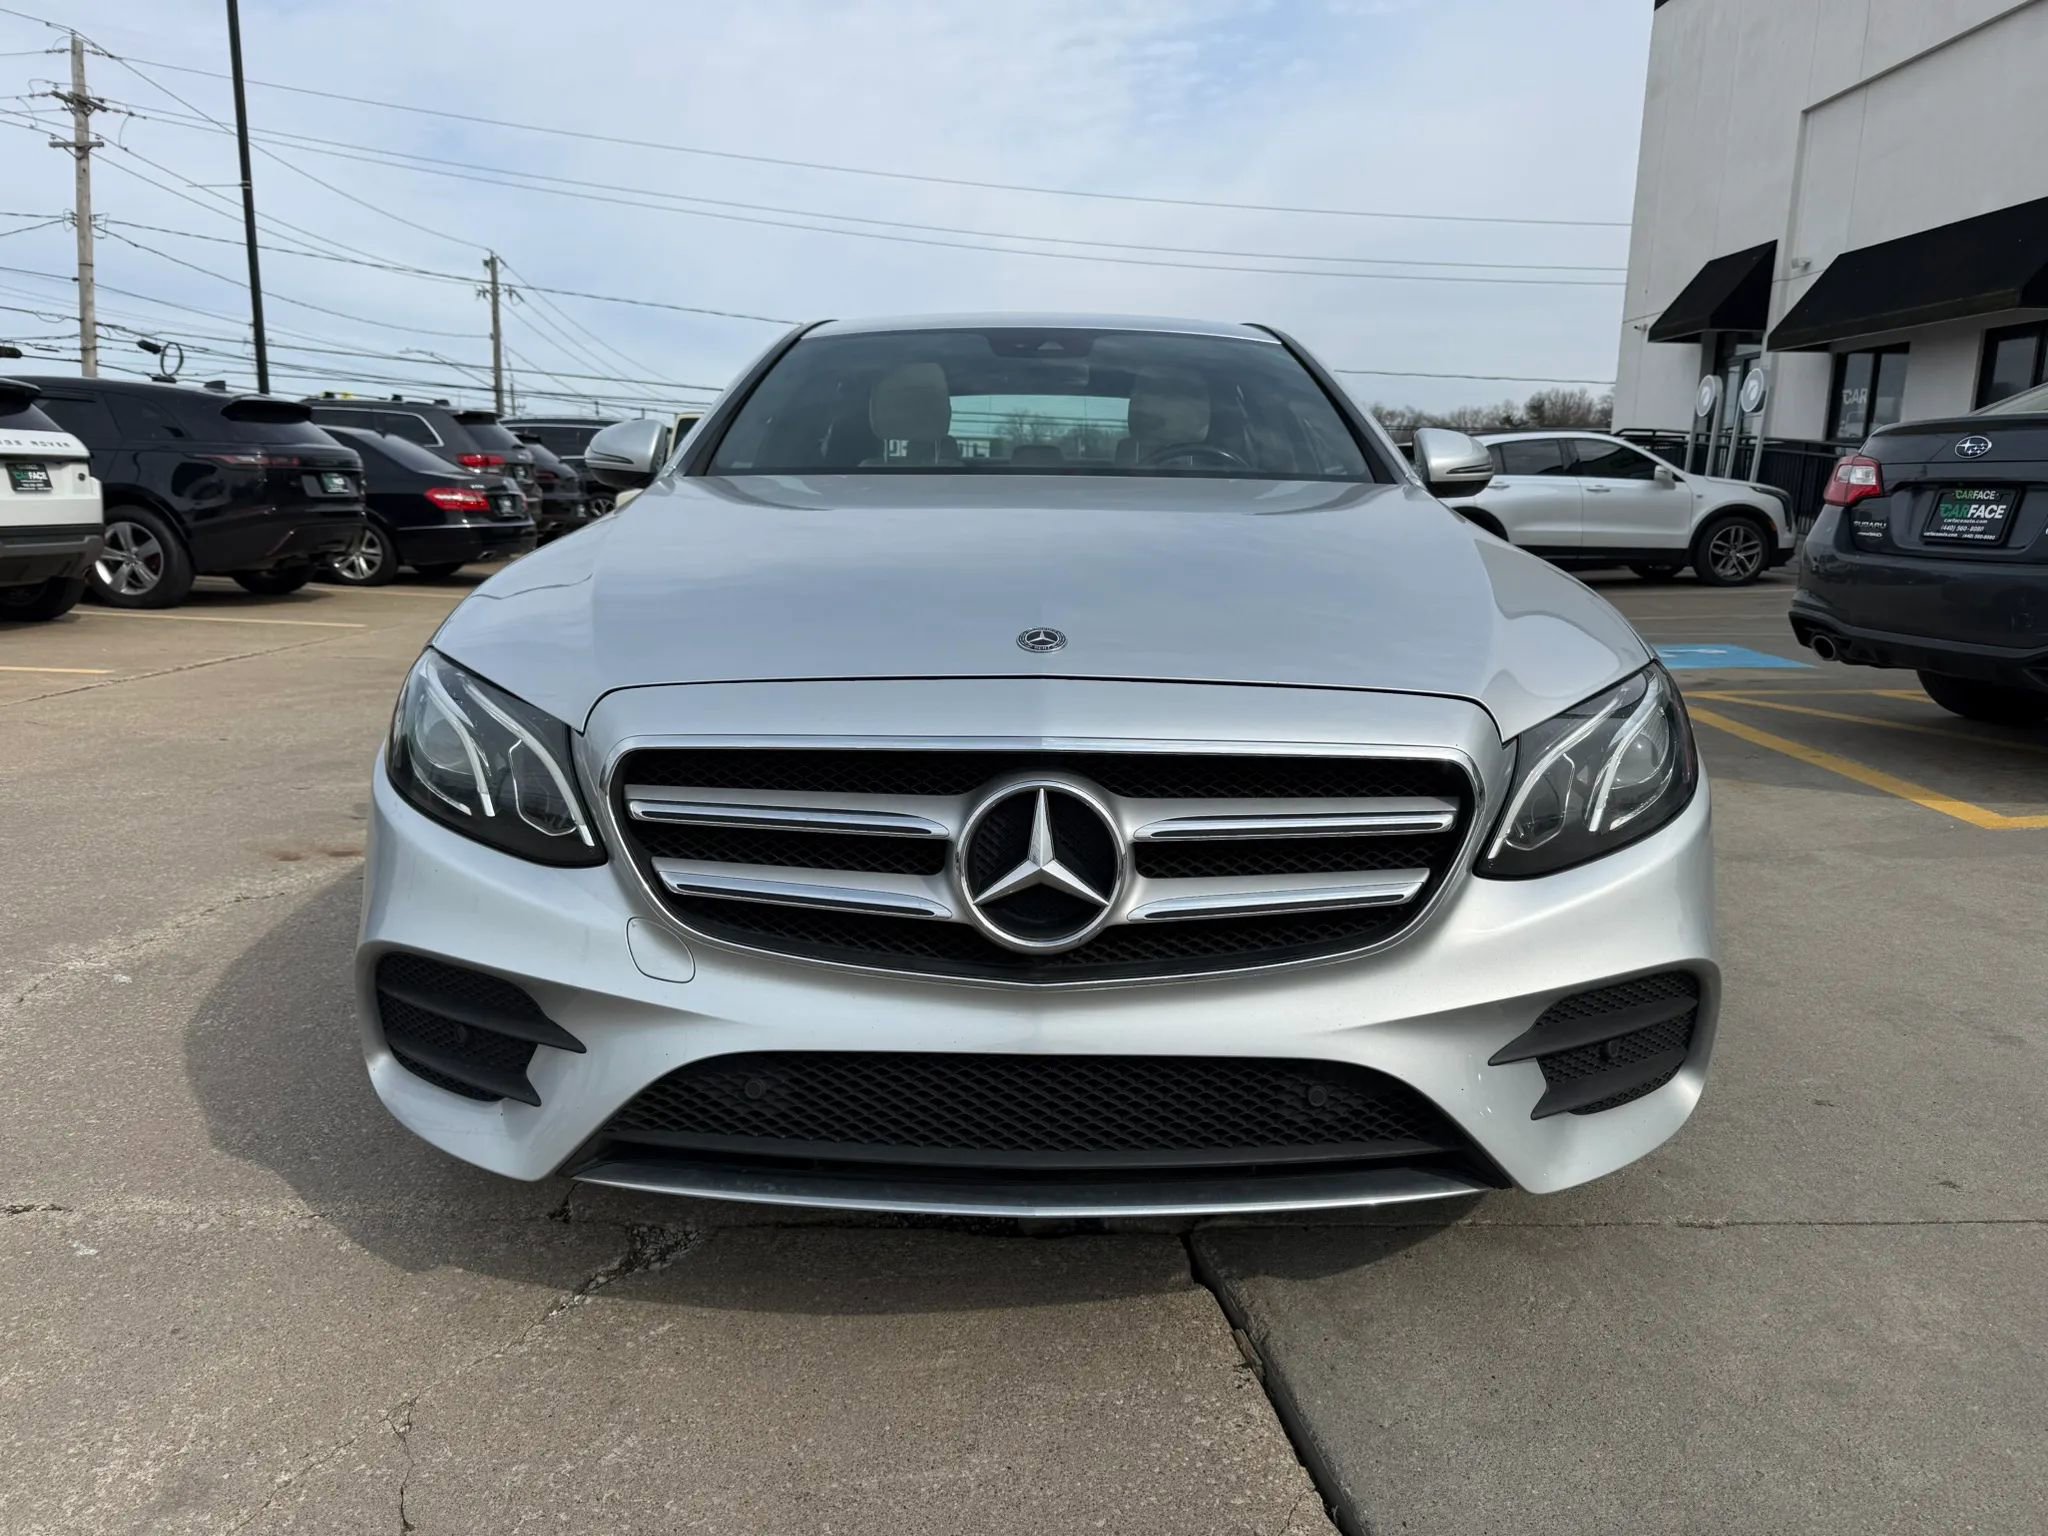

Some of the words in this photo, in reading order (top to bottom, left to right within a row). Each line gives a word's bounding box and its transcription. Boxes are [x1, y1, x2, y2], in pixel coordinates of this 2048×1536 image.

[1842, 388, 1868, 405] CAR
[30, 440, 70, 448] ROVER
[1955, 490, 1996, 500] CARFACE
[1940, 504, 2006, 519] CARFACE
[1853, 520, 1888, 529] SUBARU
